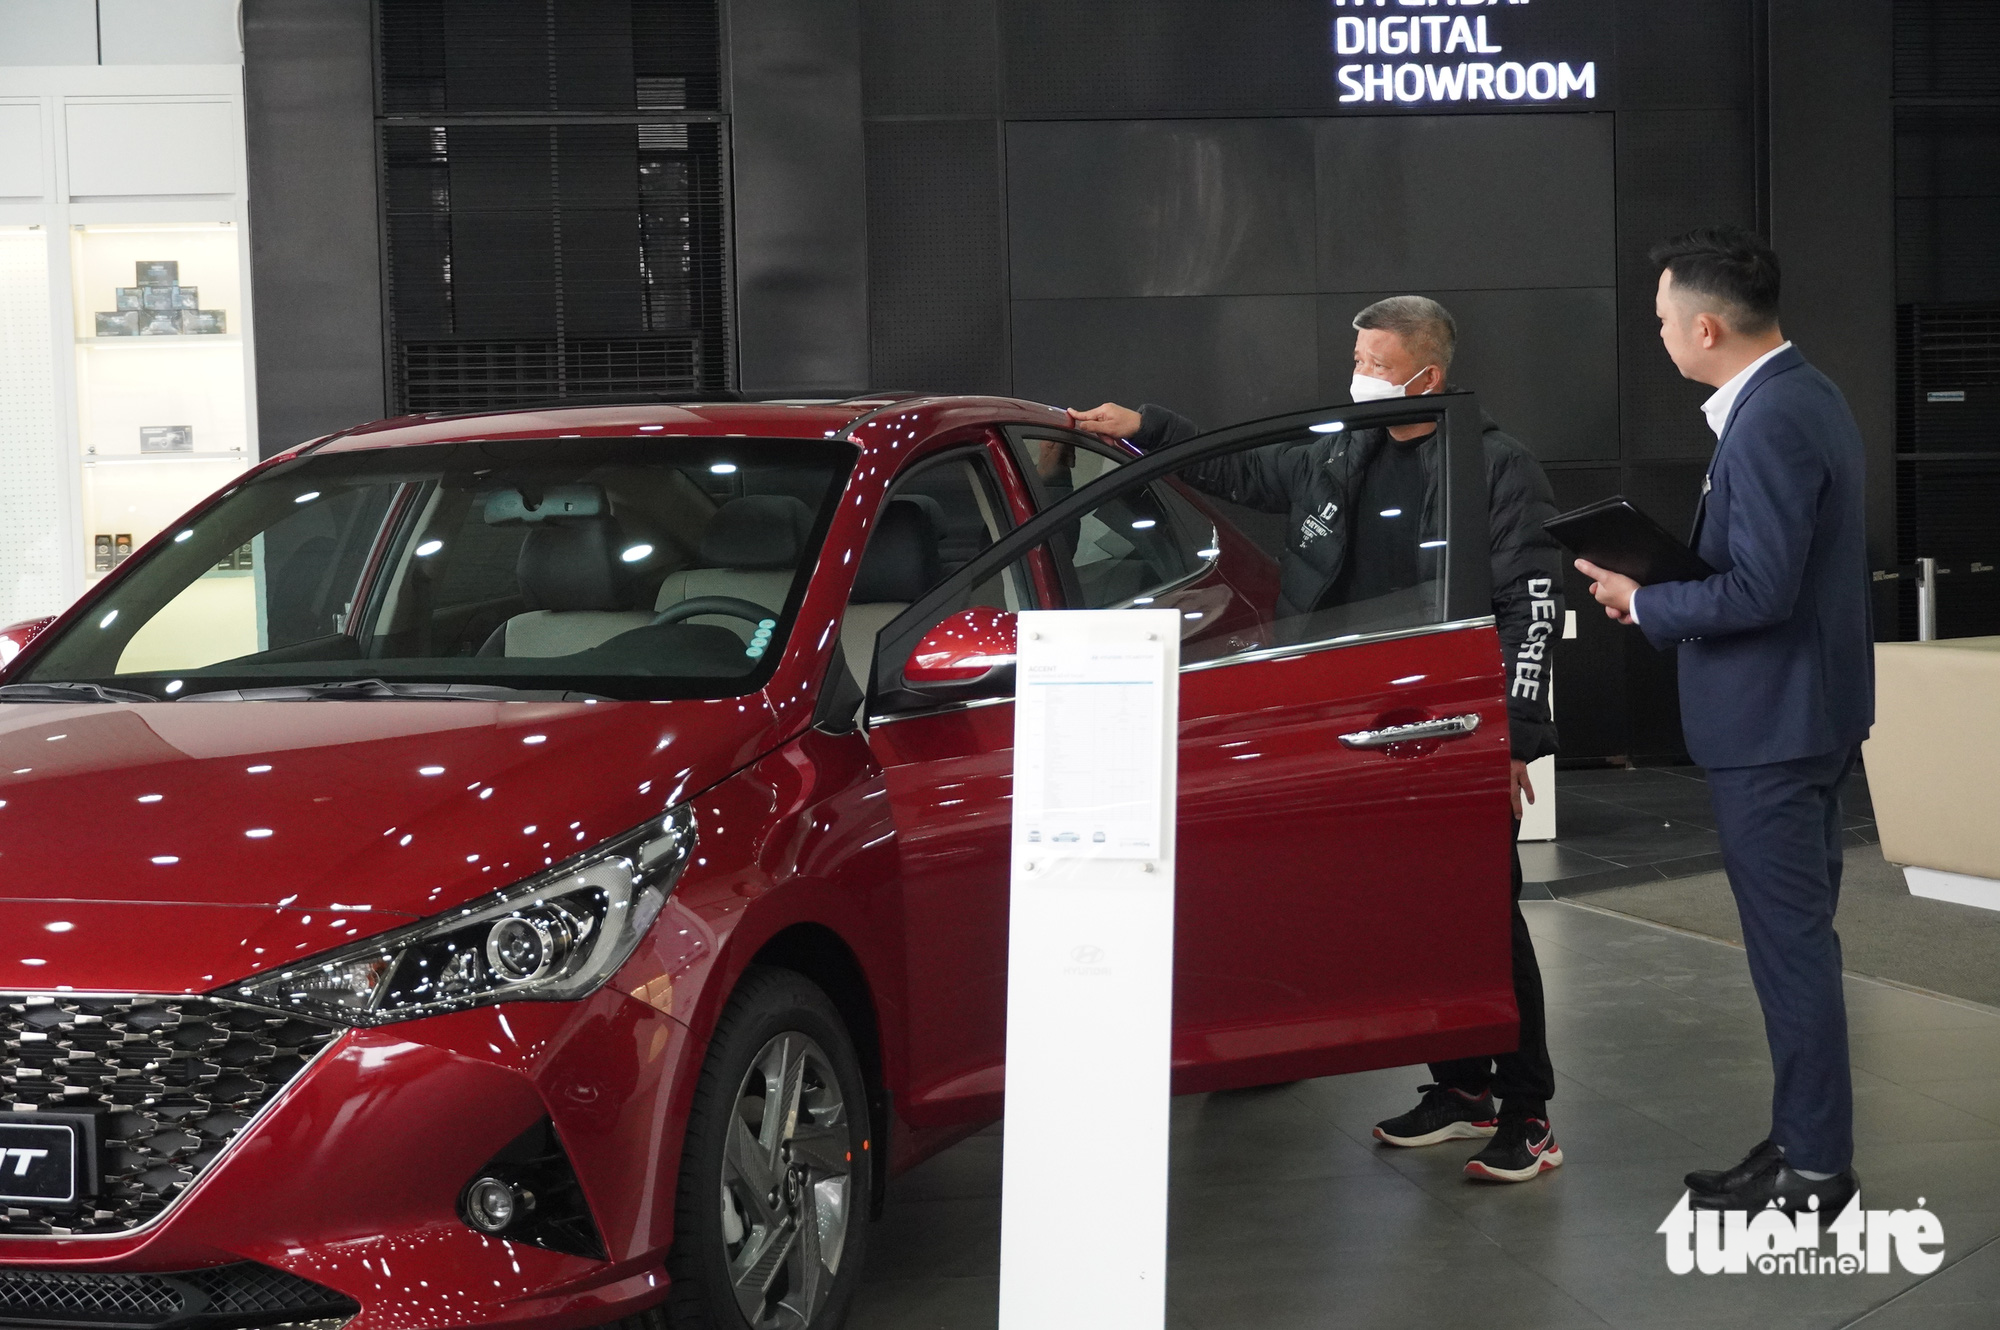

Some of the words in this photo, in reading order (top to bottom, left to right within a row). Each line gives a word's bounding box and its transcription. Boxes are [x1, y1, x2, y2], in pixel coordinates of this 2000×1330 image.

[1335, 15, 1502, 54] DIGITAL
[1337, 61, 1596, 102] SHOWROOM
[1511, 578, 1556, 701] DEGREE
